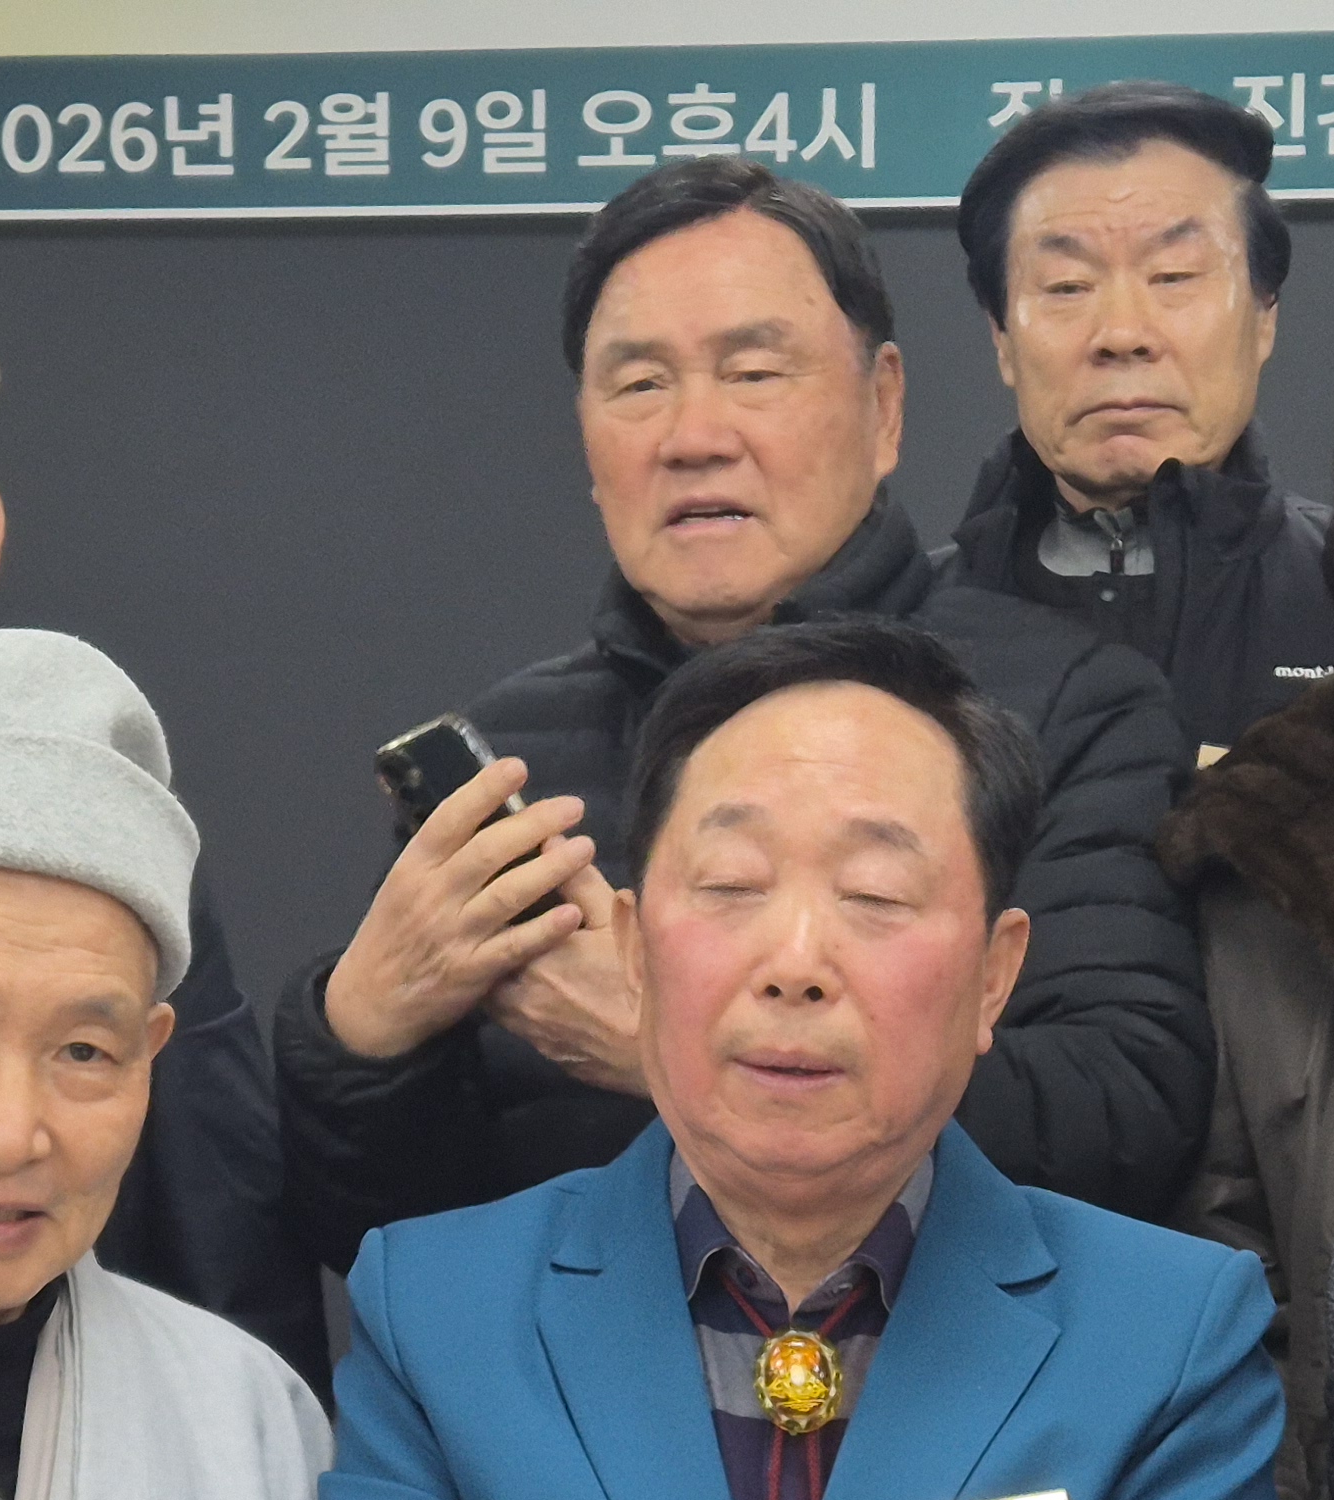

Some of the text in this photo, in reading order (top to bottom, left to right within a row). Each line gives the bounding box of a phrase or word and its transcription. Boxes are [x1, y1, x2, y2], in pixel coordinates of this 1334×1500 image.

[263, 91, 390, 176] 2월
[419, 87, 547, 174] 9일
[576, 82, 876, 169] 오후4시
